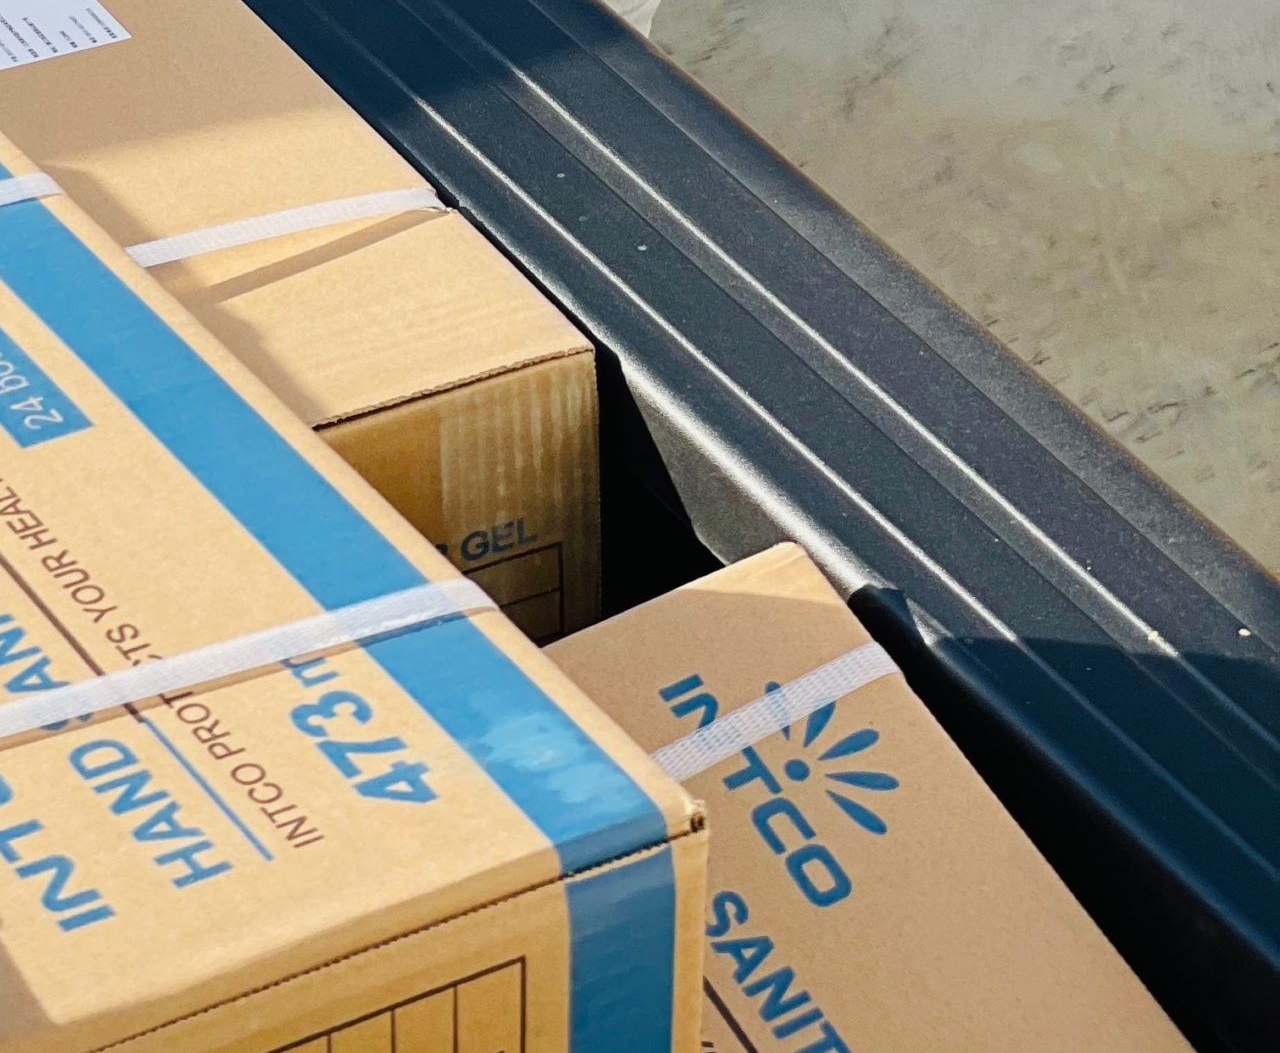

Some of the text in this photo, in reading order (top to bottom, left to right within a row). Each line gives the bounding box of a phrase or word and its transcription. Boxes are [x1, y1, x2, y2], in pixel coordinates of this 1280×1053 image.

[9, 396, 65, 430] 24
[461, 517, 538, 561] GEL
[40, 548, 119, 625] YOUR
[290, 689, 441, 804] 473
[67, 738, 234, 889] HAND
[230, 761, 326, 850] INTCO
